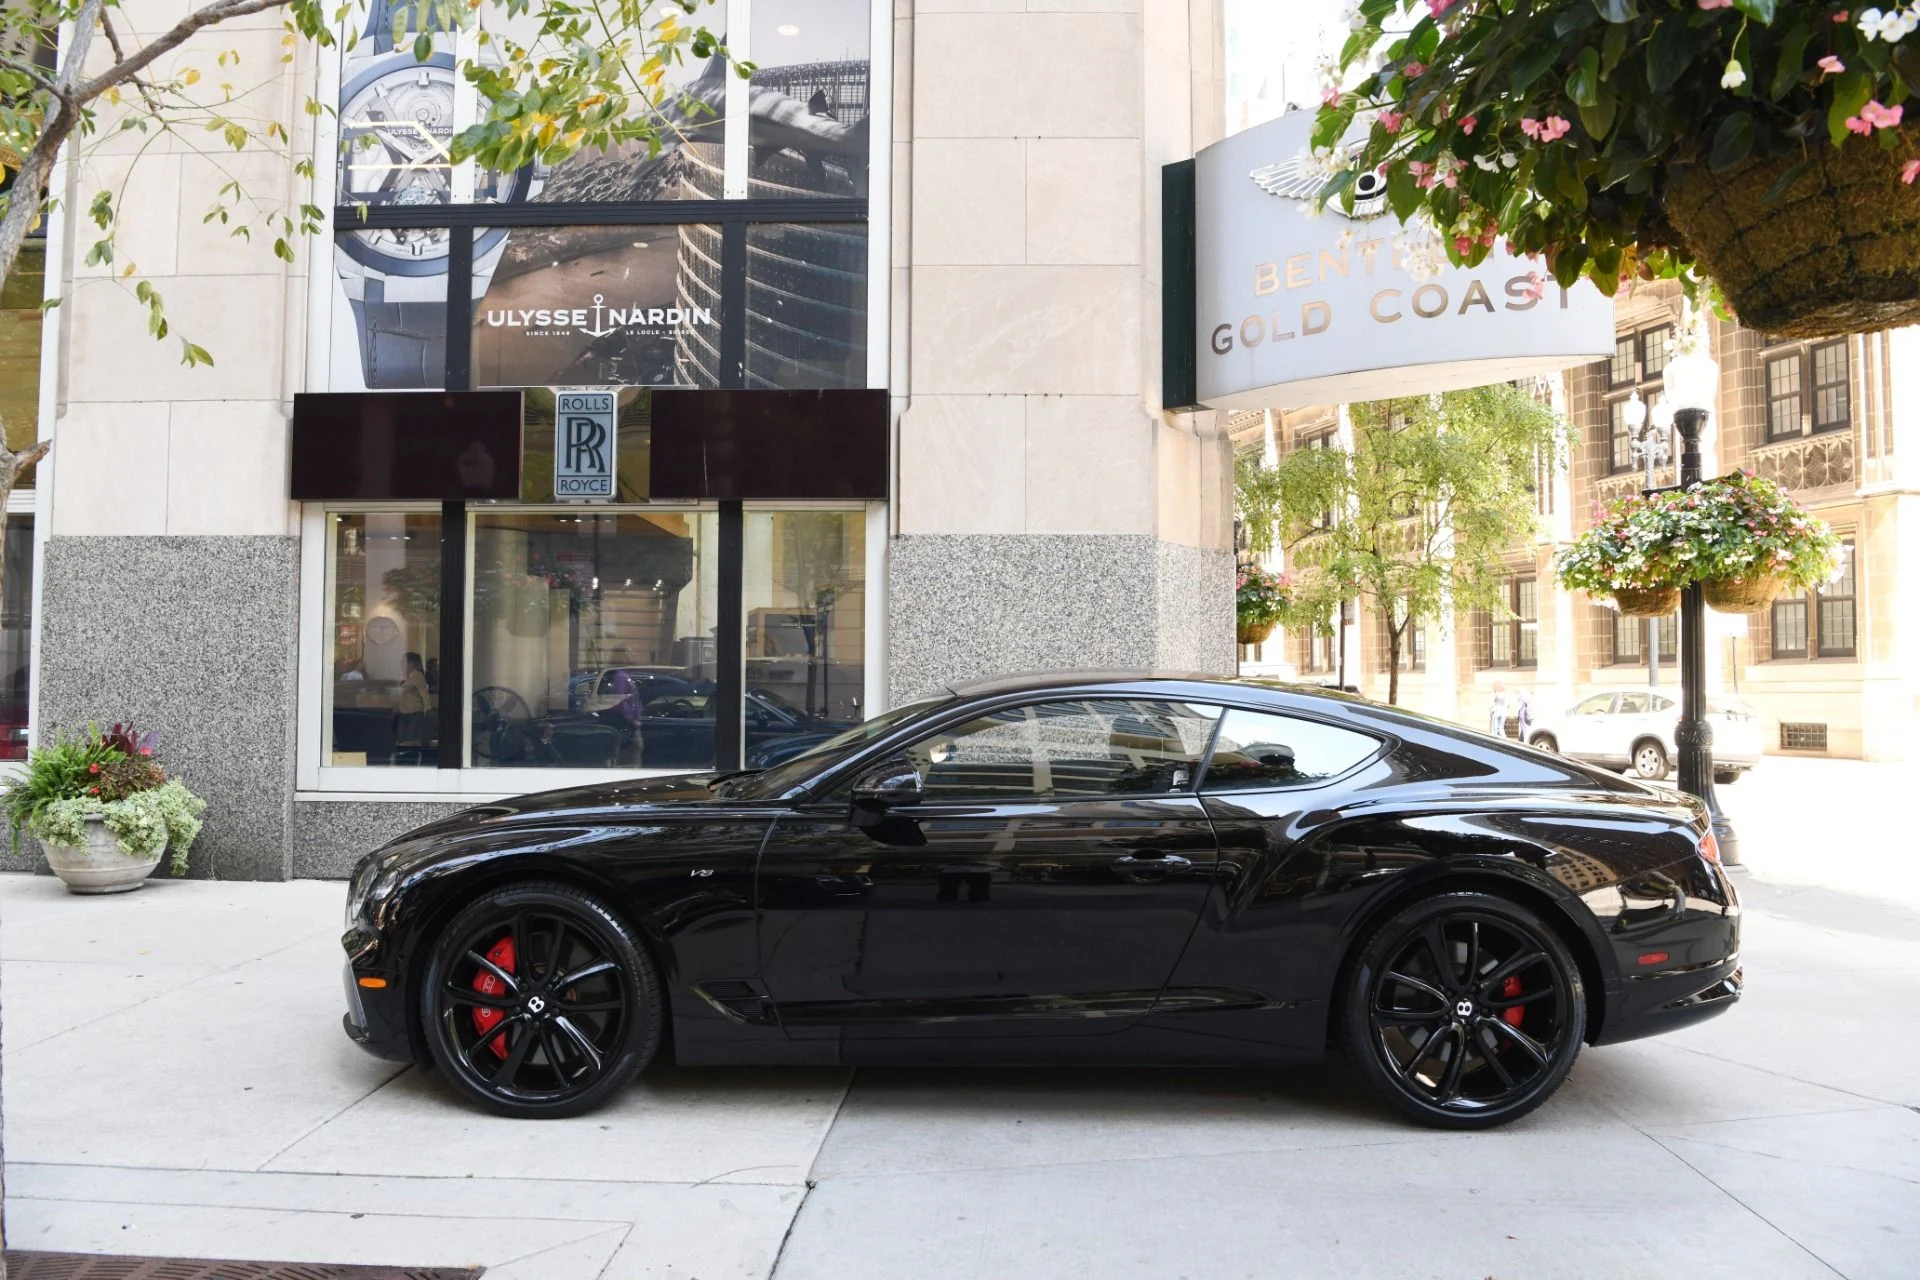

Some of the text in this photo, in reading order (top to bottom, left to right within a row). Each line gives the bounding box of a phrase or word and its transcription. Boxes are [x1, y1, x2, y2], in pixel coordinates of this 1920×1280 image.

[487, 308, 711, 327] ULYSSE NARDIN
[1211, 275, 1580, 355] GOLD COAST
[562, 398, 610, 410] ROLLS
[560, 479, 608, 491] ROYCE
[528, 996, 545, 1013] B
[1456, 1001, 1473, 1016] B
